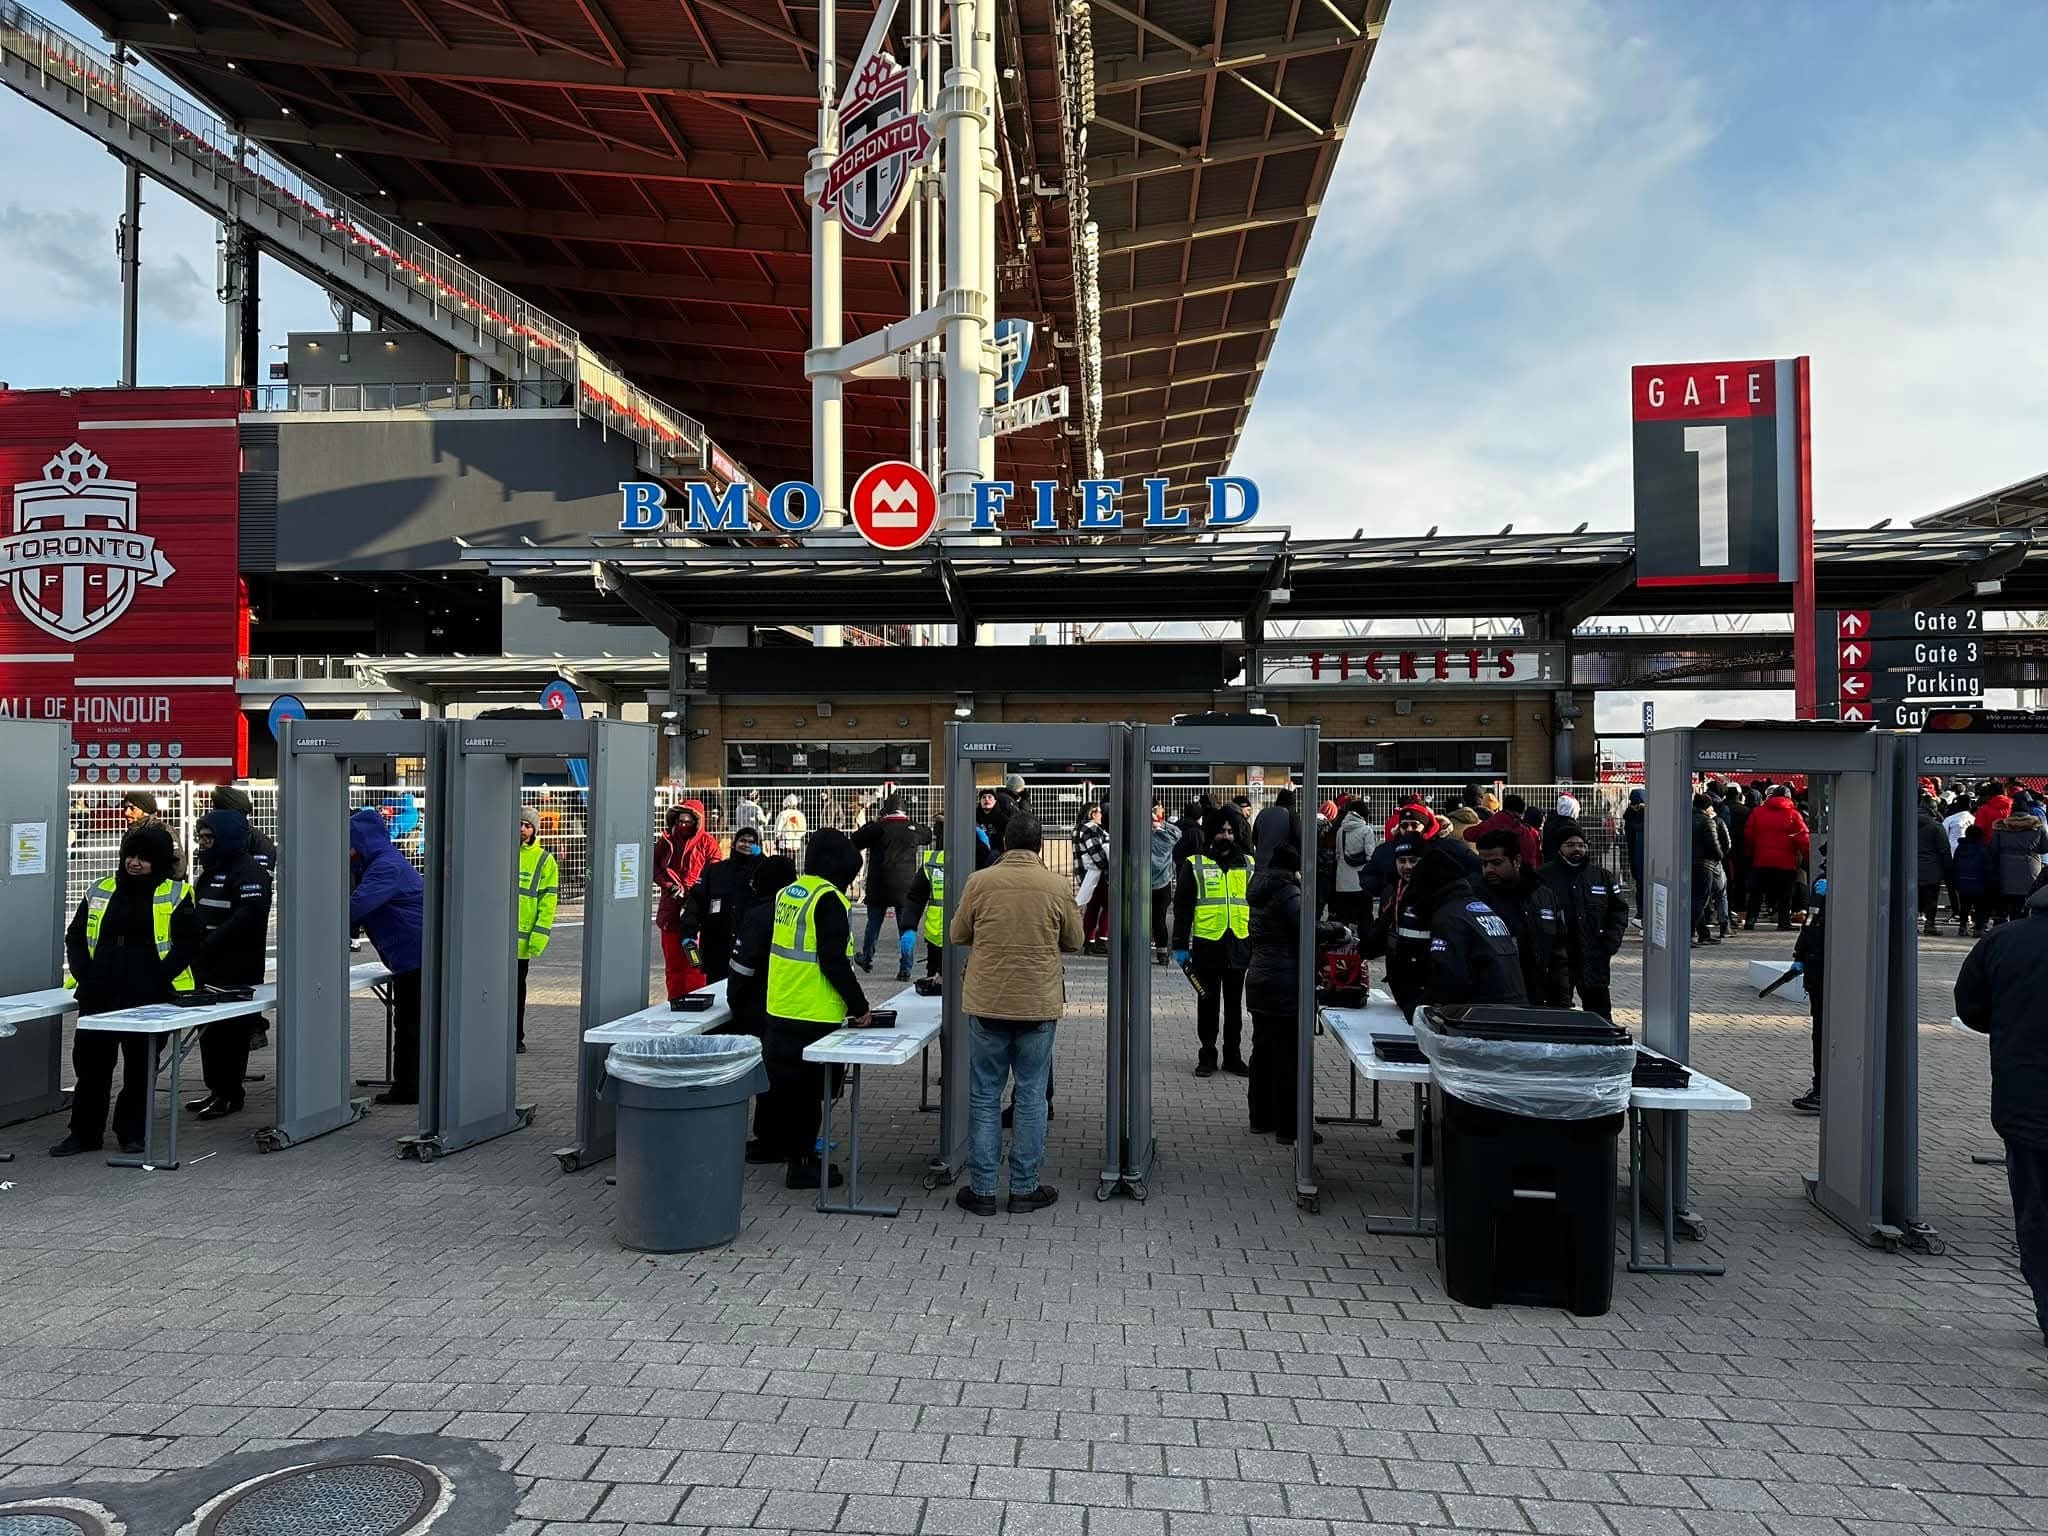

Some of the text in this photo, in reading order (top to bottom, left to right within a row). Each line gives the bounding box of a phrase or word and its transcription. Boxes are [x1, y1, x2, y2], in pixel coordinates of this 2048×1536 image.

[833, 123, 913, 183] TORONTO
[855, 167, 889, 194] F C
[1648, 374, 1761, 407] GATE
[618, 475, 1262, 532] BMO FIELD
[1683, 425, 1729, 567] 1
[3, 537, 146, 562] TORONTO
[45, 575, 103, 587] F C
[1914, 609, 1977, 632] Gate 2
[1915, 642, 1977, 664] Gate 3
[1308, 650, 1515, 681] TICKETS
[1906, 671, 1979, 697] Parking
[45, 697, 67, 718] OF
[73, 696, 170, 723] HONOUR
[1896, 705, 1928, 726] Gat
[296, 738, 326, 746] GARRETT
[464, 738, 493, 746] GARRETT
[963, 743, 997, 752] GARRETT
[1150, 745, 1185, 754] GARRETT
[1698, 751, 1739, 760] GARRETT
[1923, 756, 1967, 766] GARRETT
